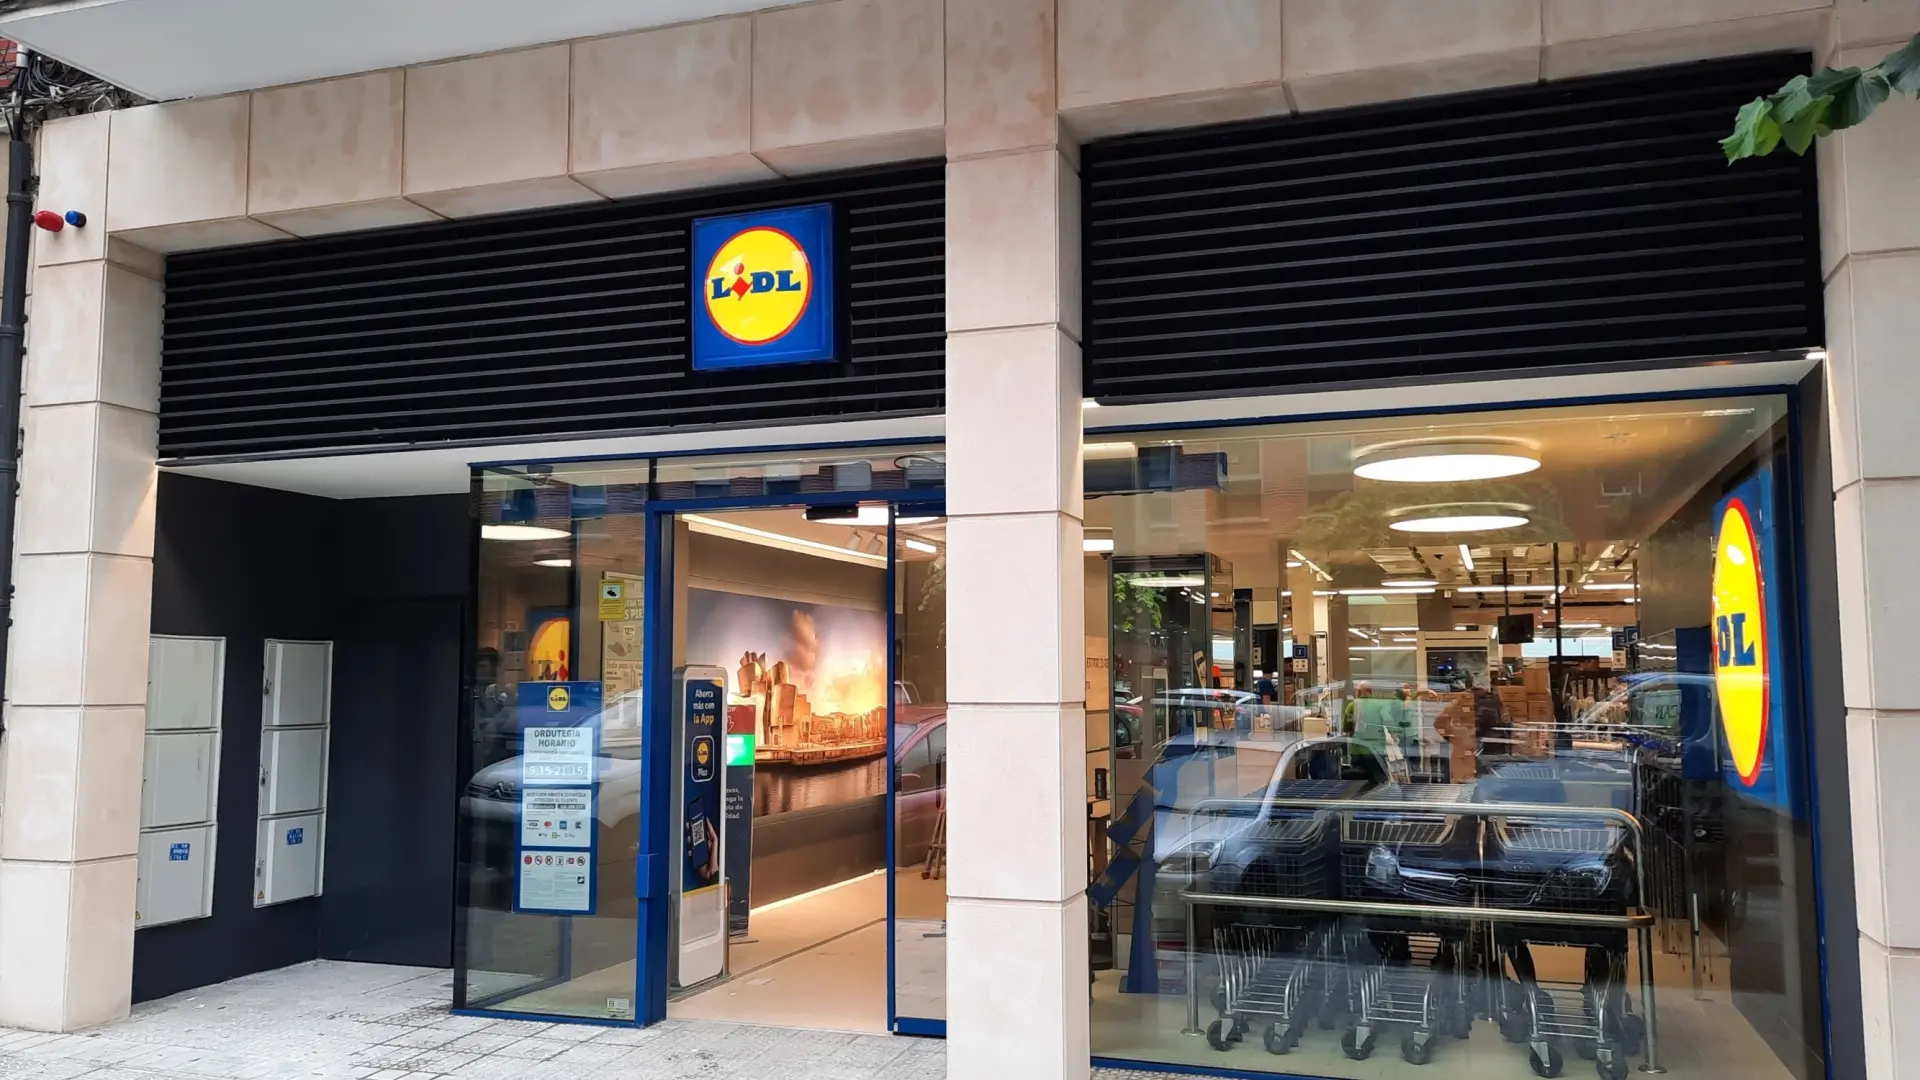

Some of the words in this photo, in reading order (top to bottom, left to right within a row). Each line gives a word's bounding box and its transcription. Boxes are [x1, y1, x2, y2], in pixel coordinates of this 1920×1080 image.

[695, 688, 713, 698] Ahorra
[693, 701, 704, 710] más
[704, 702, 715, 710] con
[693, 712, 699, 724] la
[700, 713, 714, 726] App
[534, 729, 580, 738] ORDUTEGIA
[538, 739, 576, 747] HORARIO
